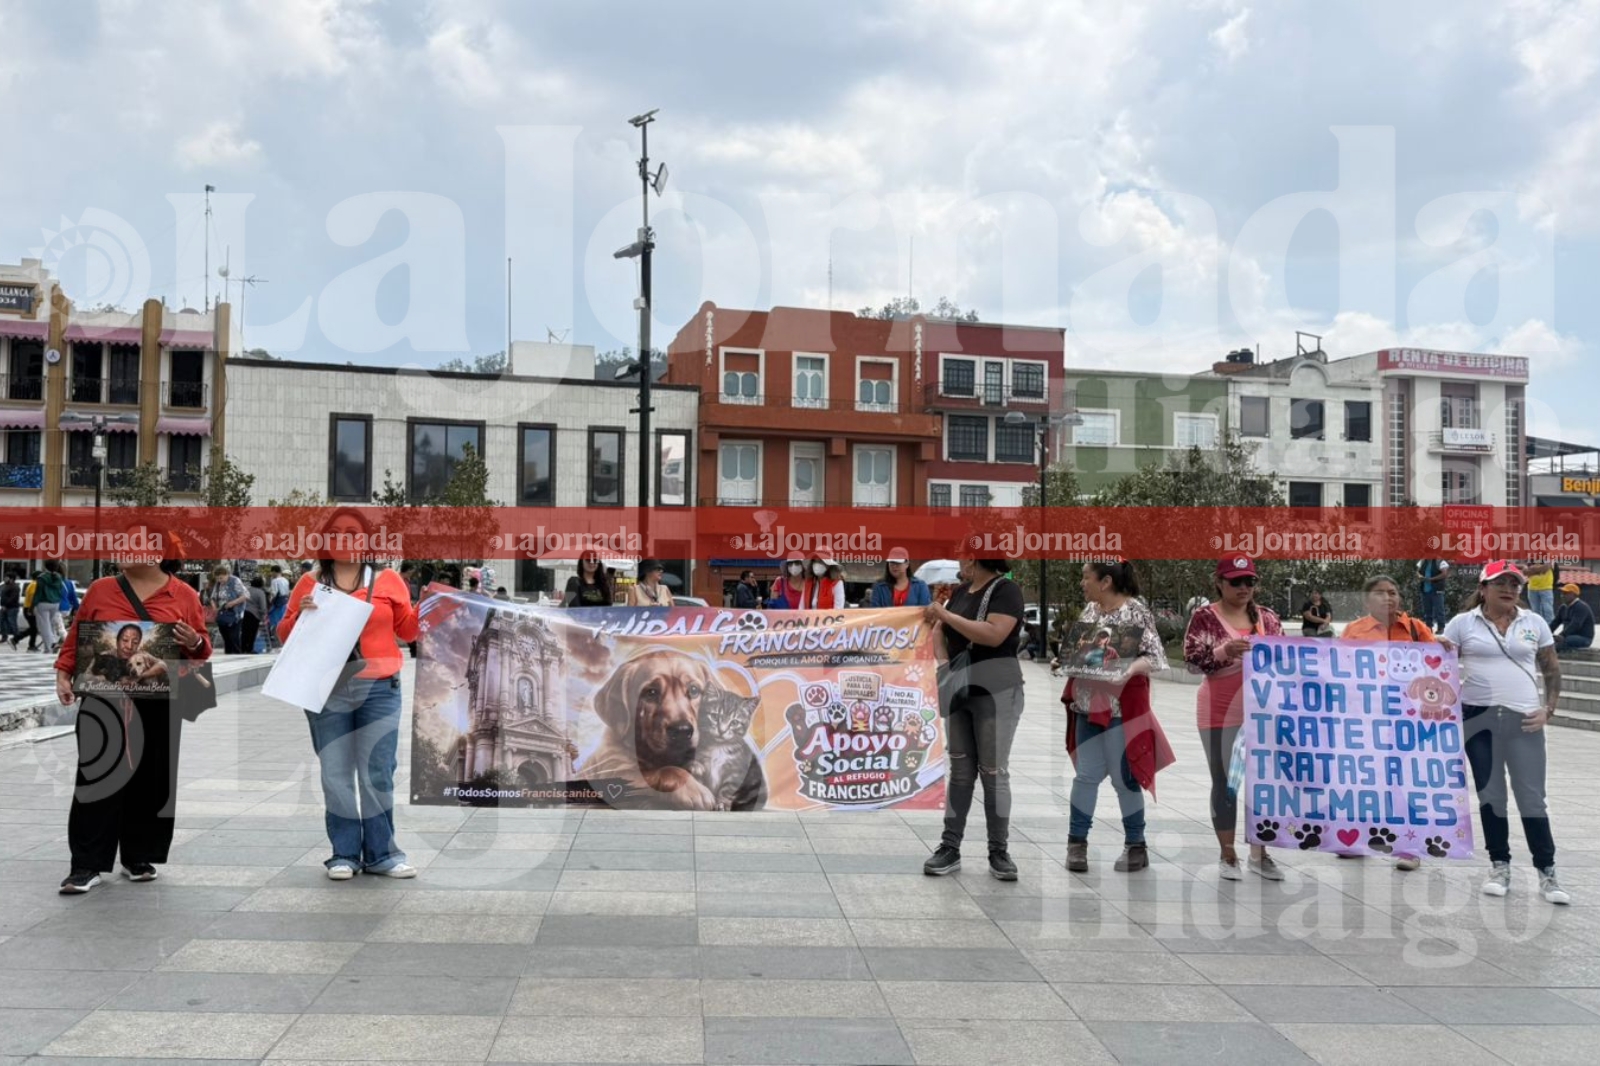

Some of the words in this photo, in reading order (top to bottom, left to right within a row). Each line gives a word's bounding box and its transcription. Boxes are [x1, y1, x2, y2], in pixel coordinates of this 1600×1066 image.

[1447, 509, 1489, 519] OFICINAS
[1447, 520, 1459, 528] EN
[1461, 520, 1489, 530] RENTA
[754, 657, 788, 666] PORQUE
[801, 654, 830, 664] AMOR
[831, 655, 841, 664] SE
[842, 655, 884, 664] ORGANIZA
[1252, 643, 1319, 678] QUE
[1330, 647, 1376, 679] LA
[1357, 683, 1402, 715] TE
[802, 726, 907, 757] Apoyo
[1251, 713, 1365, 749] TRATE
[1372, 719, 1459, 753] COMO
[816, 750, 900, 775] Social
[1251, 749, 1376, 785] TRATAS
[1385, 756, 1403, 786] A
[1411, 757, 1466, 788] LOS
[808, 777, 911, 800] FRANCISCANO
[834, 775, 844, 783] AL
[846, 772, 886, 781] REFUGIO
[1253, 783, 1458, 826] ANIMALES
